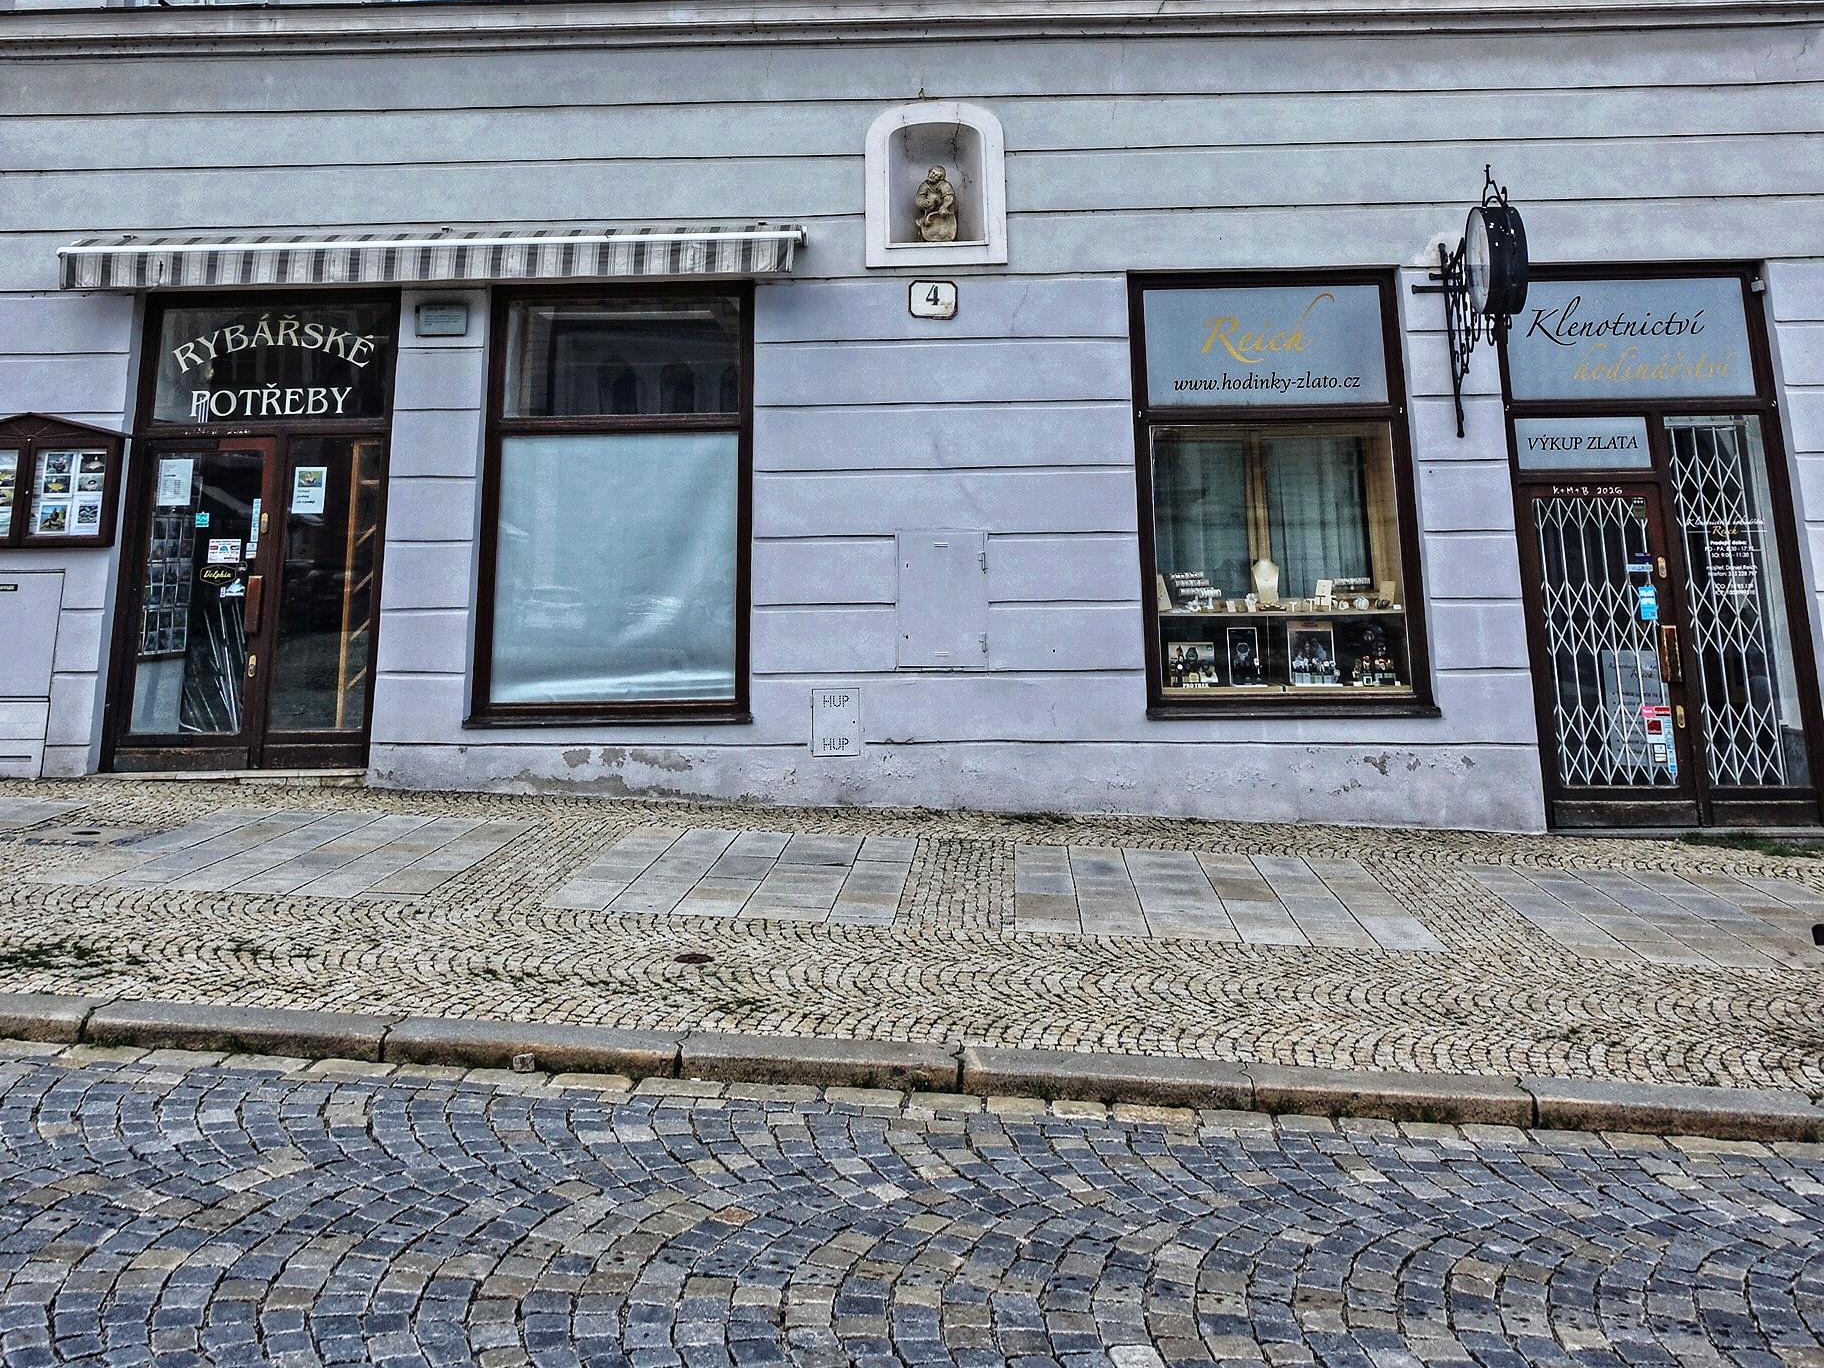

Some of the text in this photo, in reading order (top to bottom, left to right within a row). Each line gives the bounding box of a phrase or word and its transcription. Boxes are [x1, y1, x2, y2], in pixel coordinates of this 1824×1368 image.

[925, 284, 940, 305] 4
[1201, 293, 1335, 364] Reich
[1526, 296, 1705, 346] Klenotnictví
[172, 313, 375, 374] RYBÁŘSKÉ
[1174, 371, 1360, 394] www.hodinky-zlato.cz
[189, 382, 353, 417] POTŘEBY
[1527, 433, 1639, 451] VÝKUP ZLATA
[1597, 486, 1623, 495] 2026
[823, 695, 850, 708] HUP
[823, 737, 850, 751] HUP
